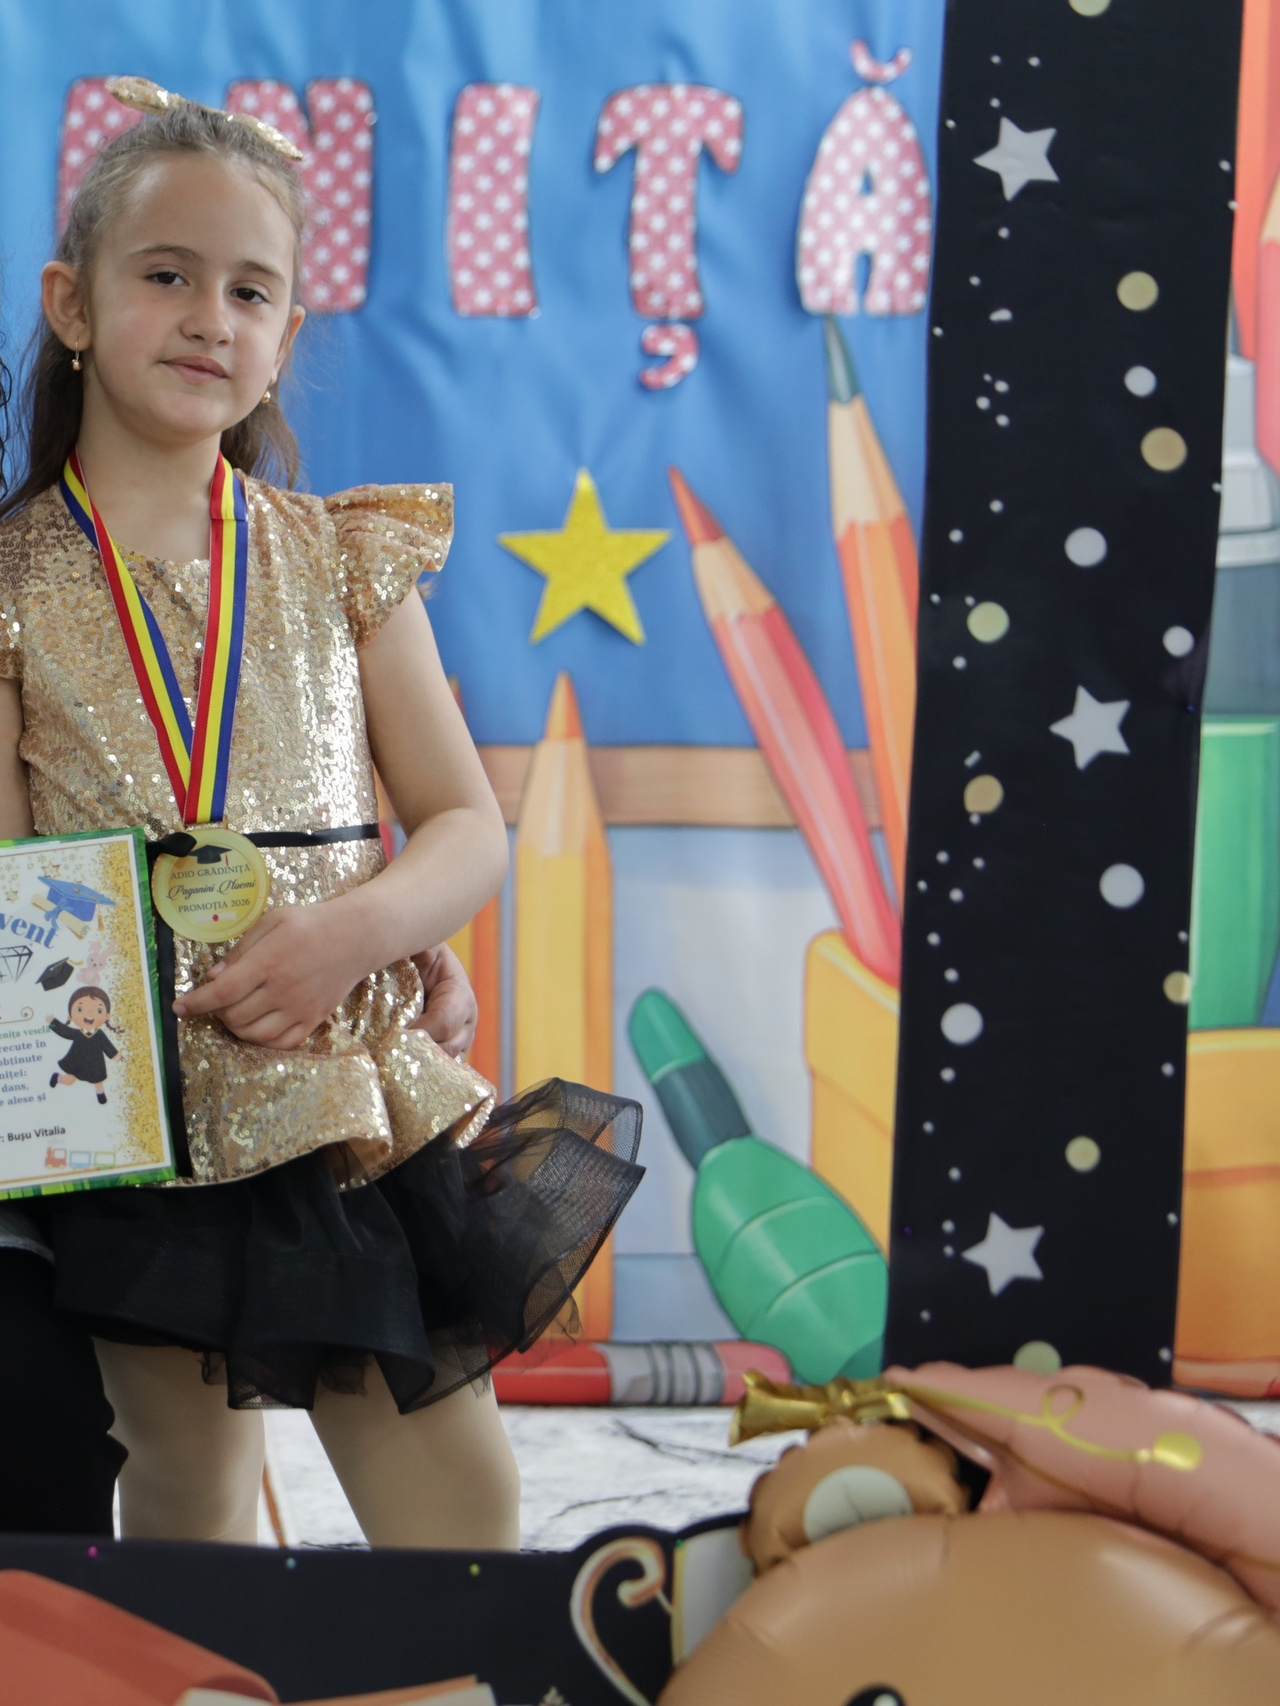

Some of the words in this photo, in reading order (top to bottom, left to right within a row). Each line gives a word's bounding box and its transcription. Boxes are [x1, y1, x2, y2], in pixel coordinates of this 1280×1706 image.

[170, 871, 195, 880] ADIO
[166, 884, 215, 900] Paganini
[216, 879, 257, 895] Noemi
[231, 898, 251, 908] 2026
[7, 1094, 34, 1105] alese
[34, 1125, 66, 1138] Vitalia
